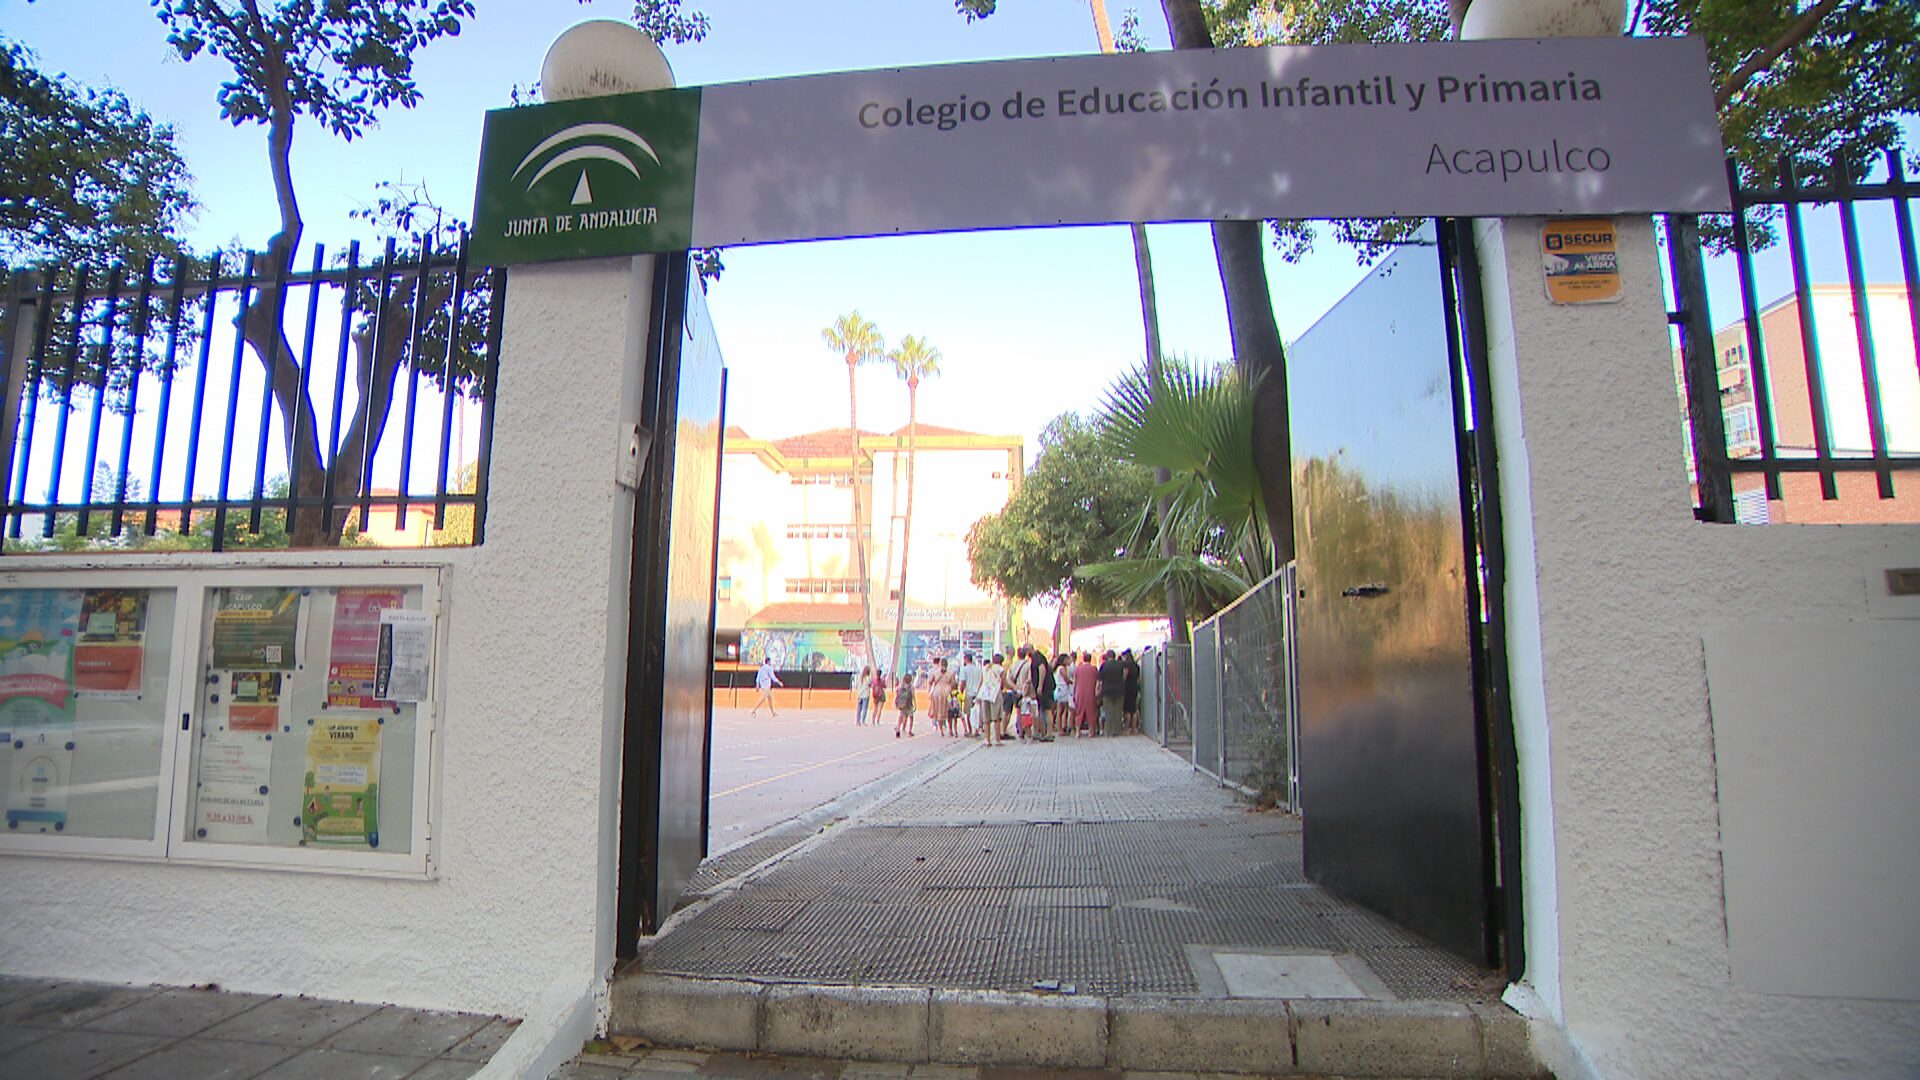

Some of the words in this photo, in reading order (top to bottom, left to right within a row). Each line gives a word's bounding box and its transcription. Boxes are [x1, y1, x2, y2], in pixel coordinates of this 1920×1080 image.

[858, 95, 991, 131] Colegio
[1001, 91, 1046, 119] de
[1057, 78, 1248, 117] Educación
[1260, 75, 1396, 108] Infantil
[1405, 82, 1426, 112] y
[1437, 72, 1602, 104] Primaria
[1425, 139, 1611, 183] Acapulco
[504, 217, 548, 237] JUNTA
[556, 215, 573, 233] DE
